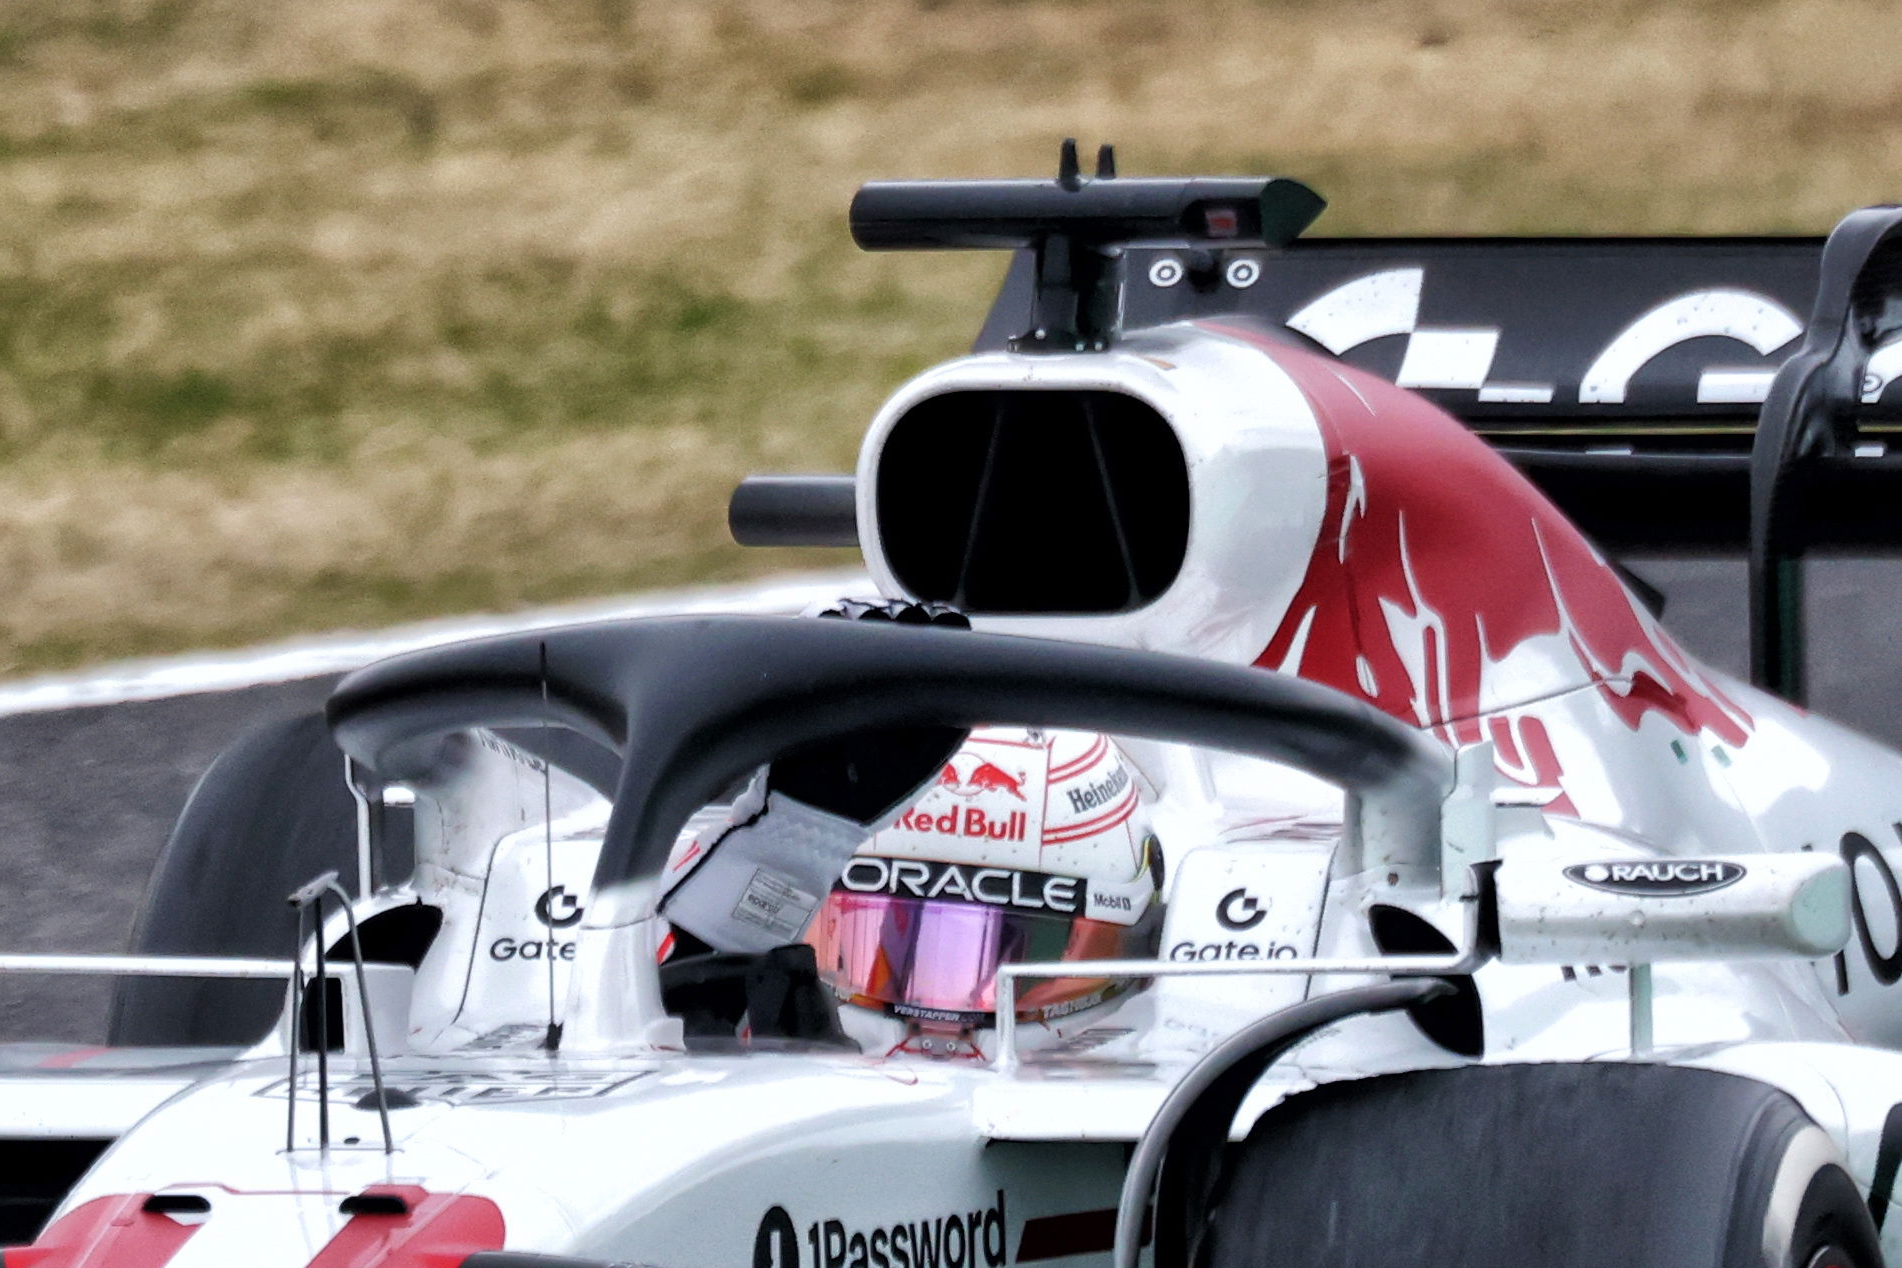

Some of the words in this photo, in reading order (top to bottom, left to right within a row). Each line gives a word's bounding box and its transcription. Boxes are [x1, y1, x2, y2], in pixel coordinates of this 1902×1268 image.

[964, 808, 1027, 842] Bull
[841, 857, 1078, 913] ORACLE
[1612, 864, 1727, 882] RAUCH
